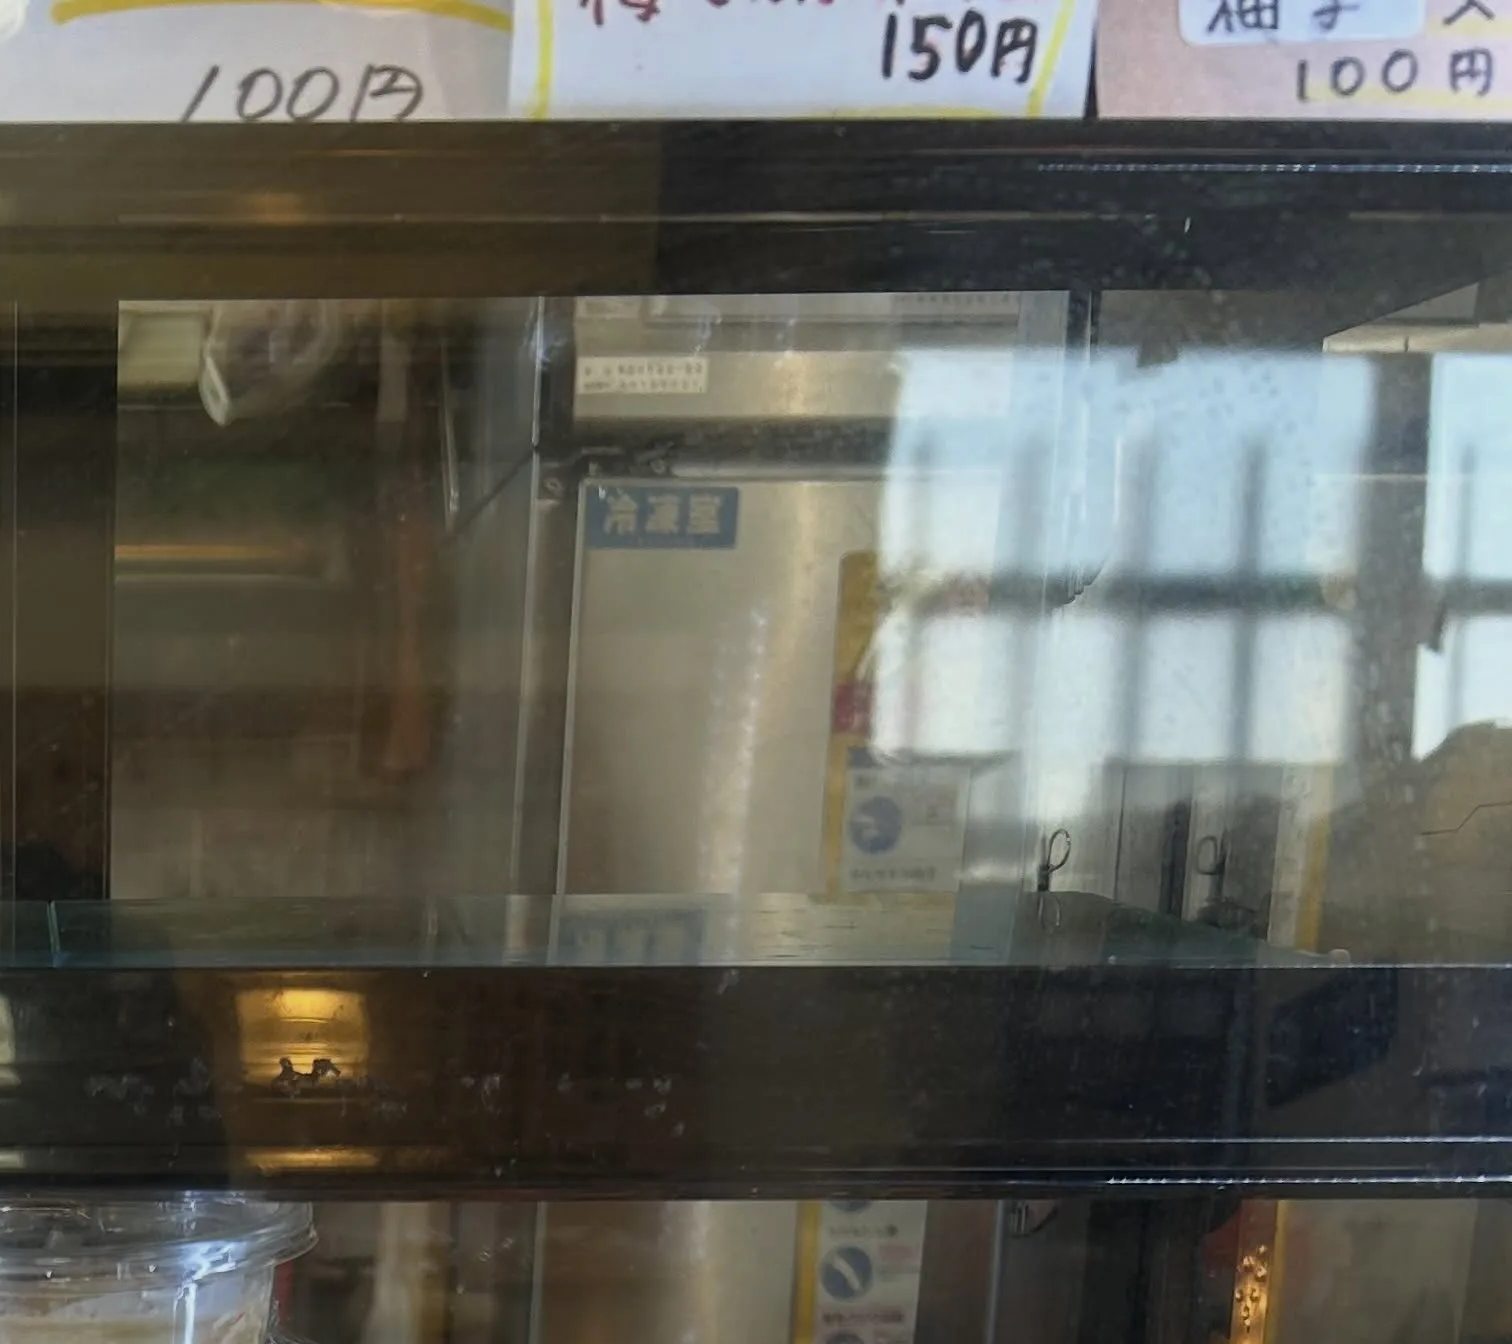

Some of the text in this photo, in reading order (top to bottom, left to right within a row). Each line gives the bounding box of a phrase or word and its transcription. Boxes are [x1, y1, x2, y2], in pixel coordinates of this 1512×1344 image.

[881, 9, 1038, 83] 150円
[180, 64, 424, 122] 100円
[1296, 48, 1494, 103] 100円
